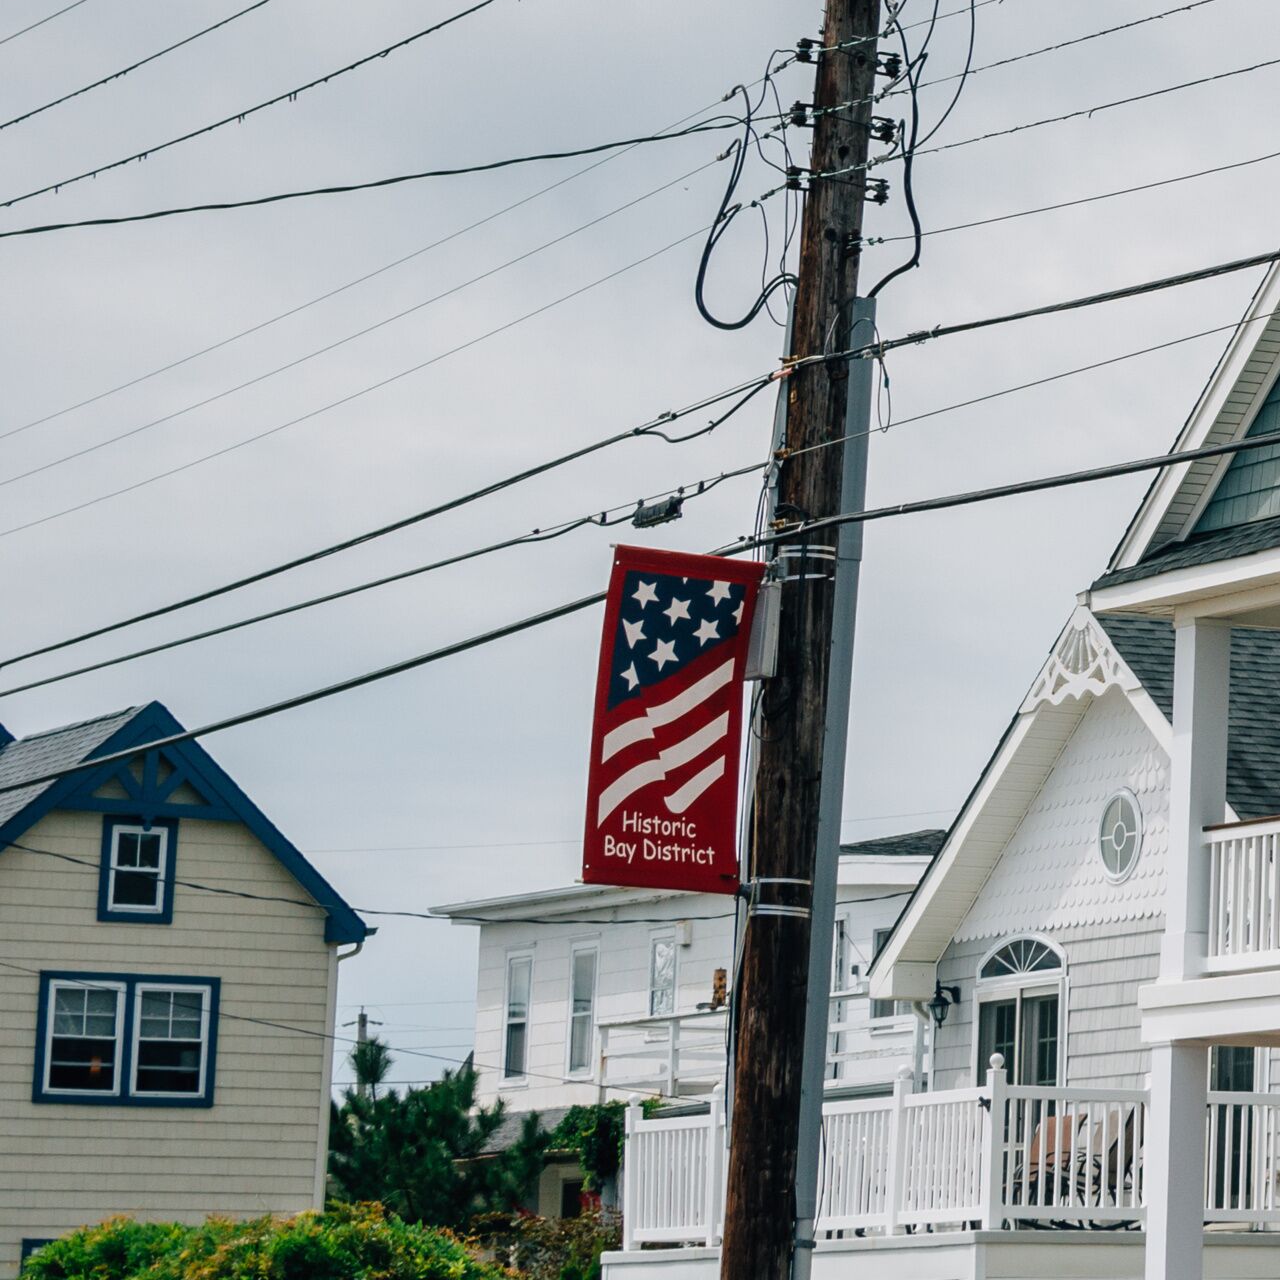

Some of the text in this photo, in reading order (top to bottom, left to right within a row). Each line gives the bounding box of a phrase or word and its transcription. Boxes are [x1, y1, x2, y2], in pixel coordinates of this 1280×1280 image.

[622, 810, 697, 838] Historic
[604, 835, 715, 865] Bay District
